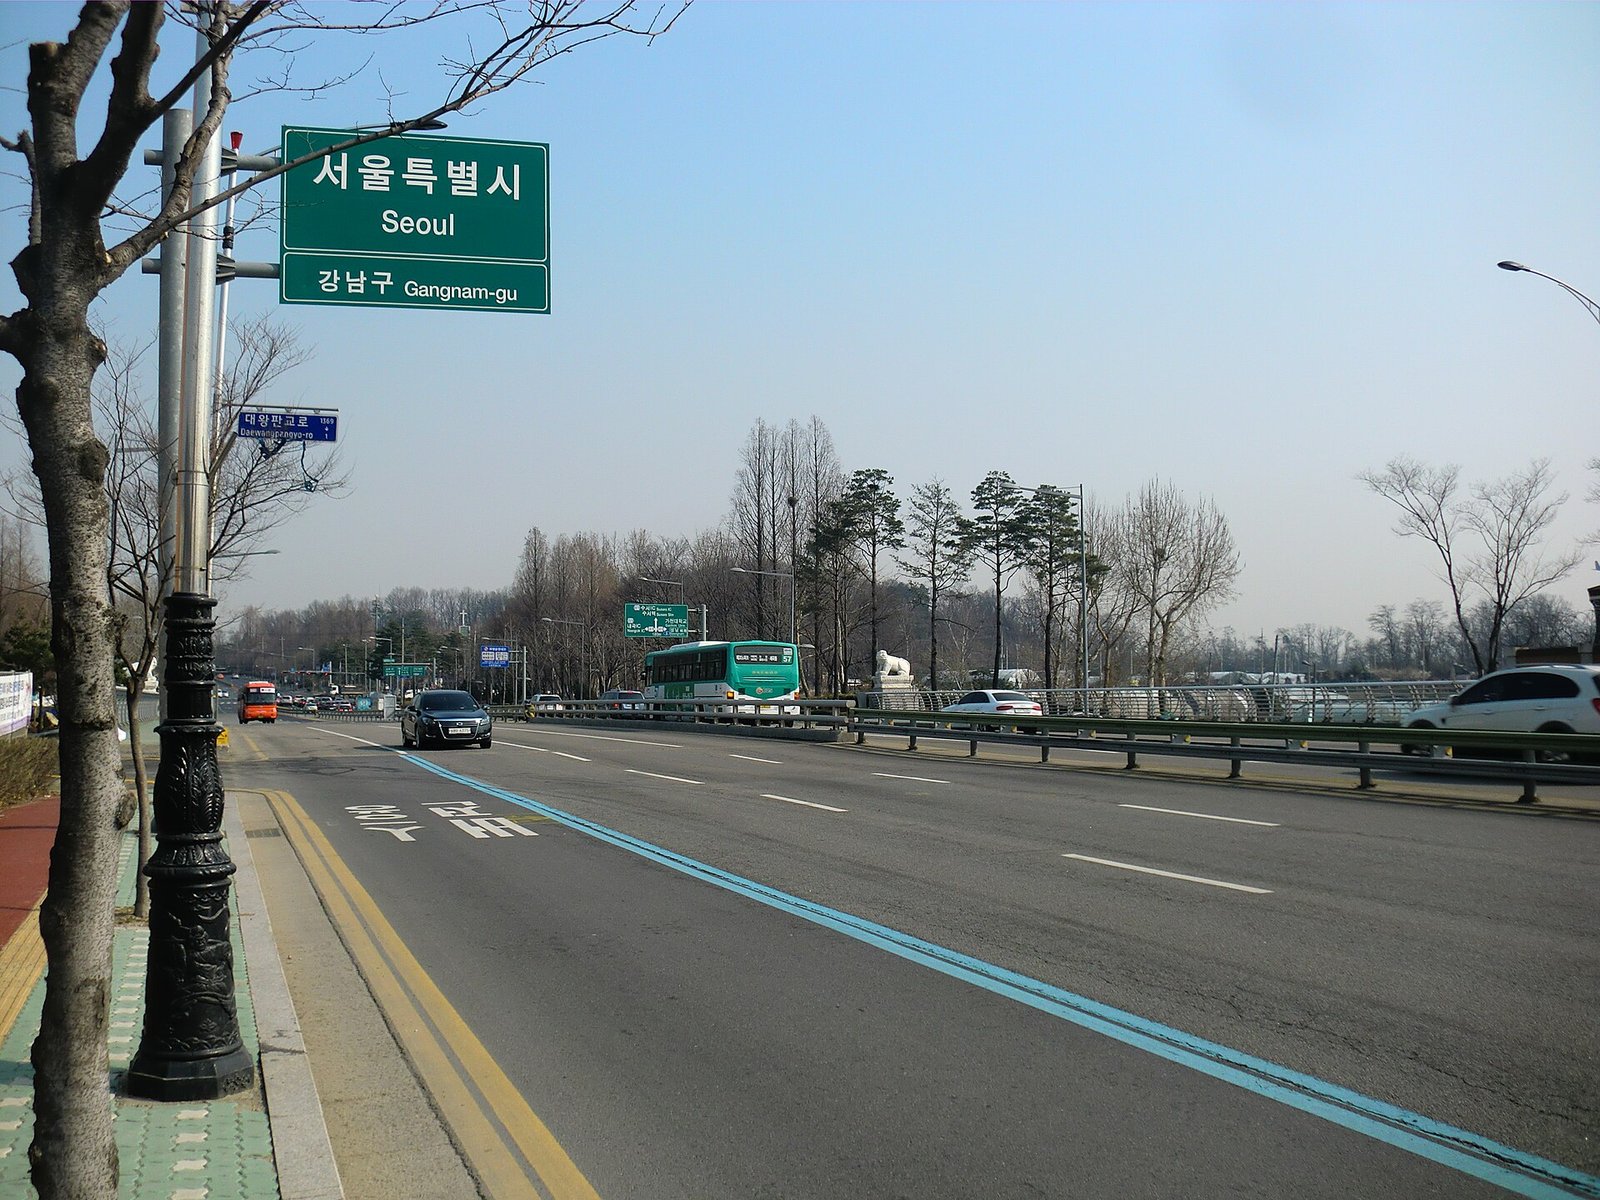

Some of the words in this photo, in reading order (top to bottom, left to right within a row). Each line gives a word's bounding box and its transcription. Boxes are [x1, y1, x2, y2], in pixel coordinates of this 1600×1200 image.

[313, 152, 520, 201] 서울특별시
[381, 209, 455, 236] Seoul
[318, 269, 394, 294] 강남구
[404, 280, 518, 304] Gangnam-gu
[245, 414, 309, 428] 대왕판교로
